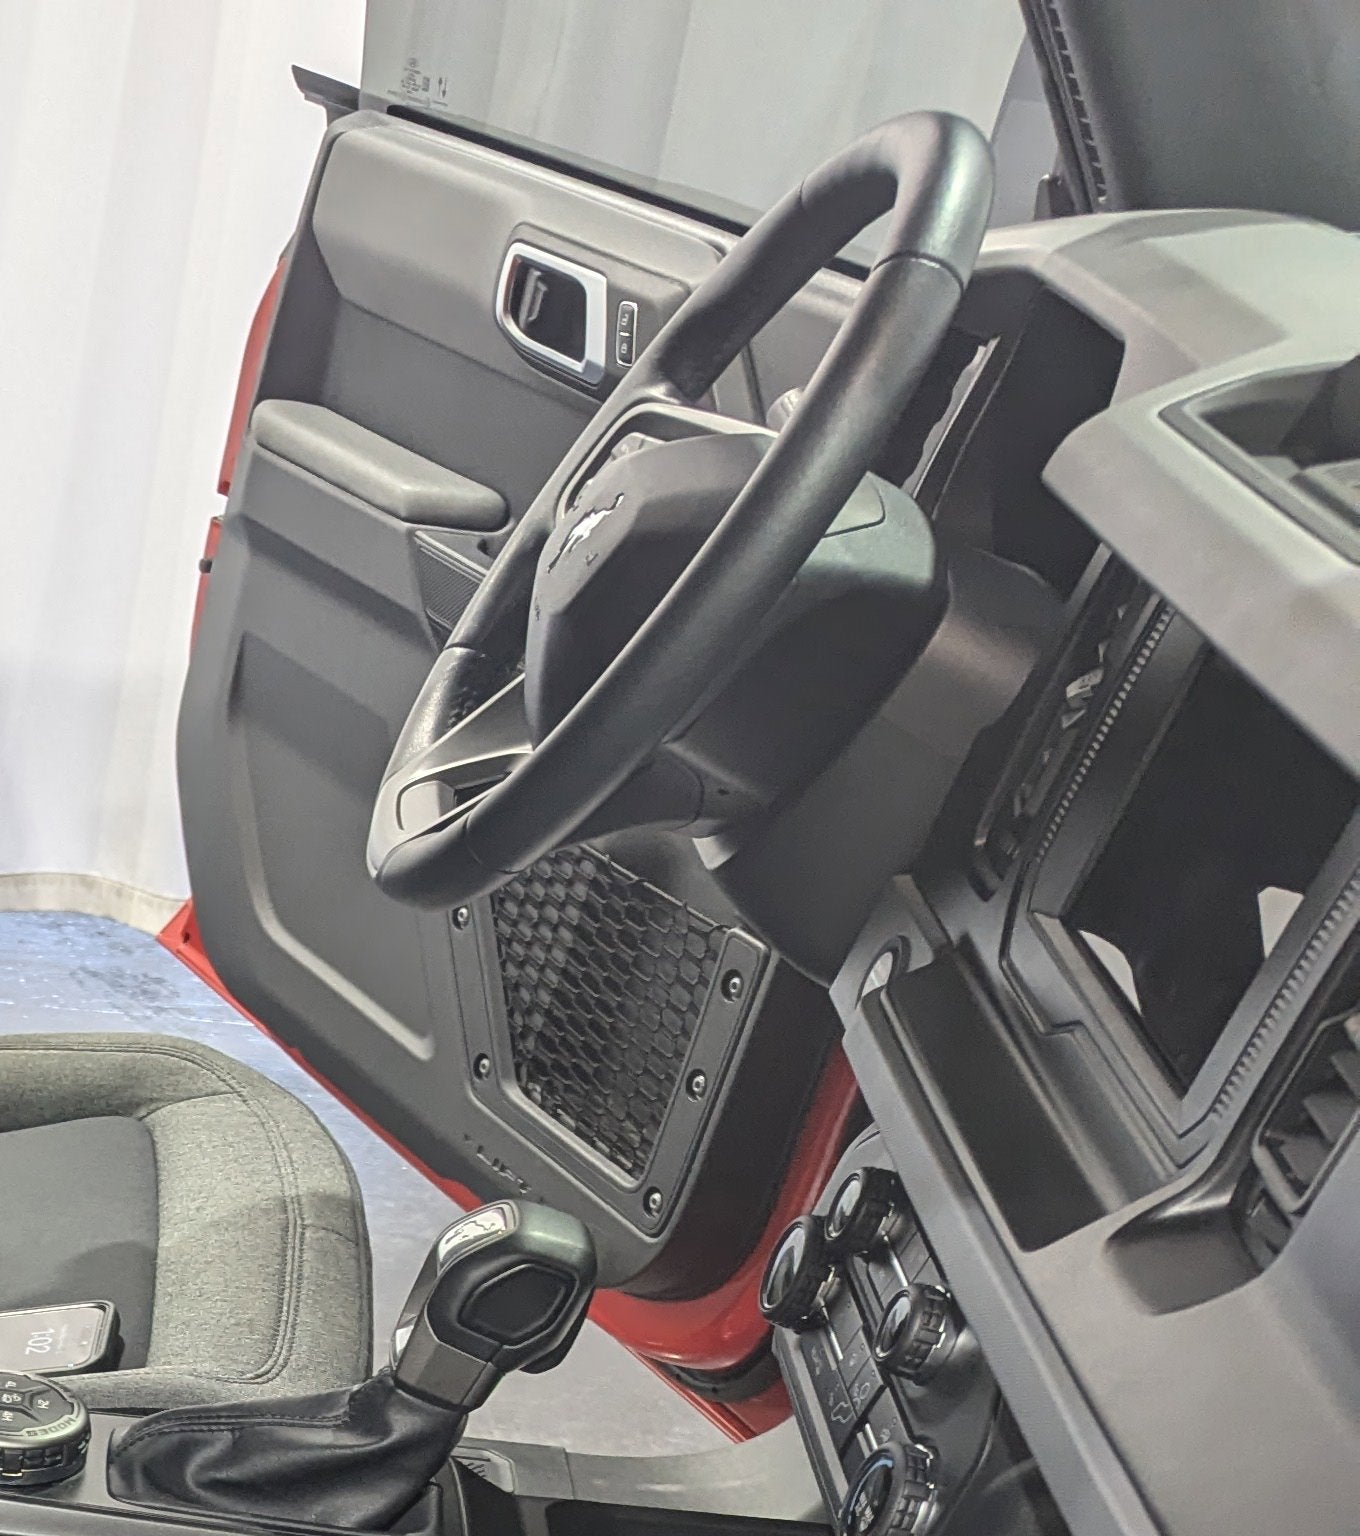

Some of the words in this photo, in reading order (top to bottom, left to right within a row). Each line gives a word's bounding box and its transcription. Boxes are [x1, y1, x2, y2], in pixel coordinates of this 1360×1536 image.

[25, 1328, 56, 1355] 1:02
[37, 1399, 49, 1409] 2H
[39, 1417, 76, 1436] MODE
